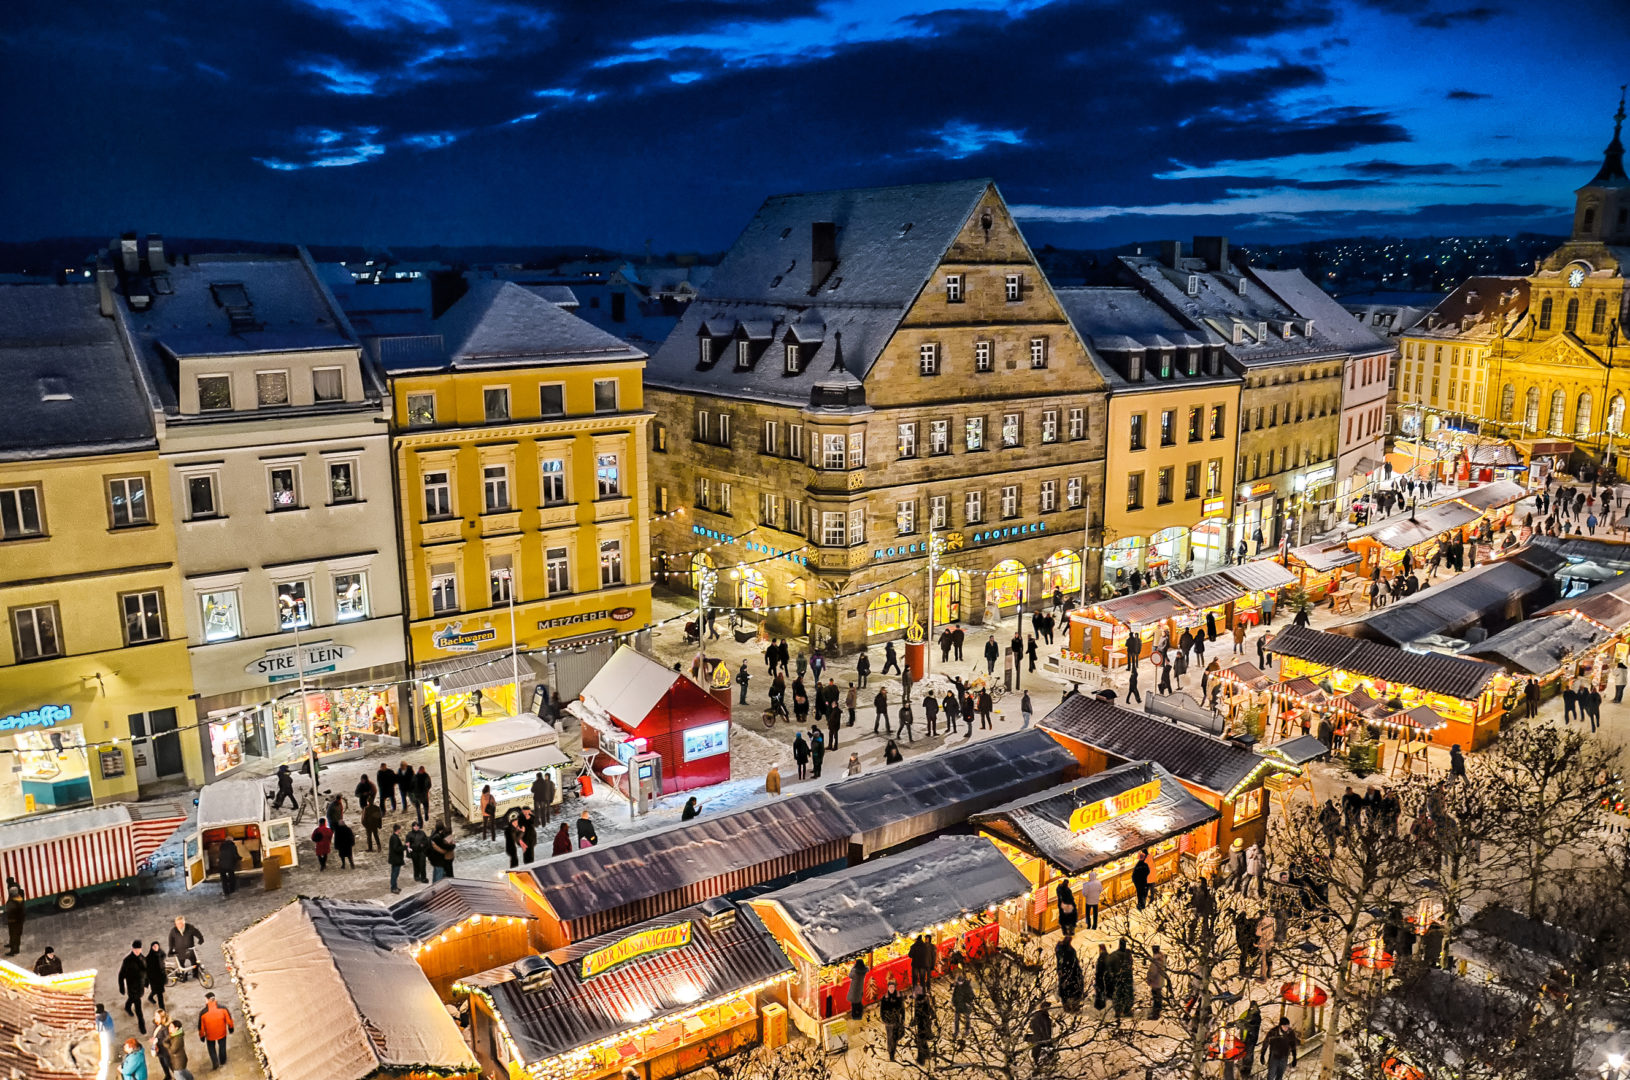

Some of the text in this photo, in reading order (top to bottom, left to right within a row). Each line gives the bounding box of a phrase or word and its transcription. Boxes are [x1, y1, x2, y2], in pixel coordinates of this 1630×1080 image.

[693, 525, 807, 566] MOHREN APOTHEKE
[874, 522, 1046, 559] MOHRE APOTHEKE
[538, 610, 609, 630] METZGEREI
[440, 632, 493, 647] Backwaren
[0, 704, 72, 730] chlöffel
[596, 929, 678, 968] DER NUSSKNACKER
